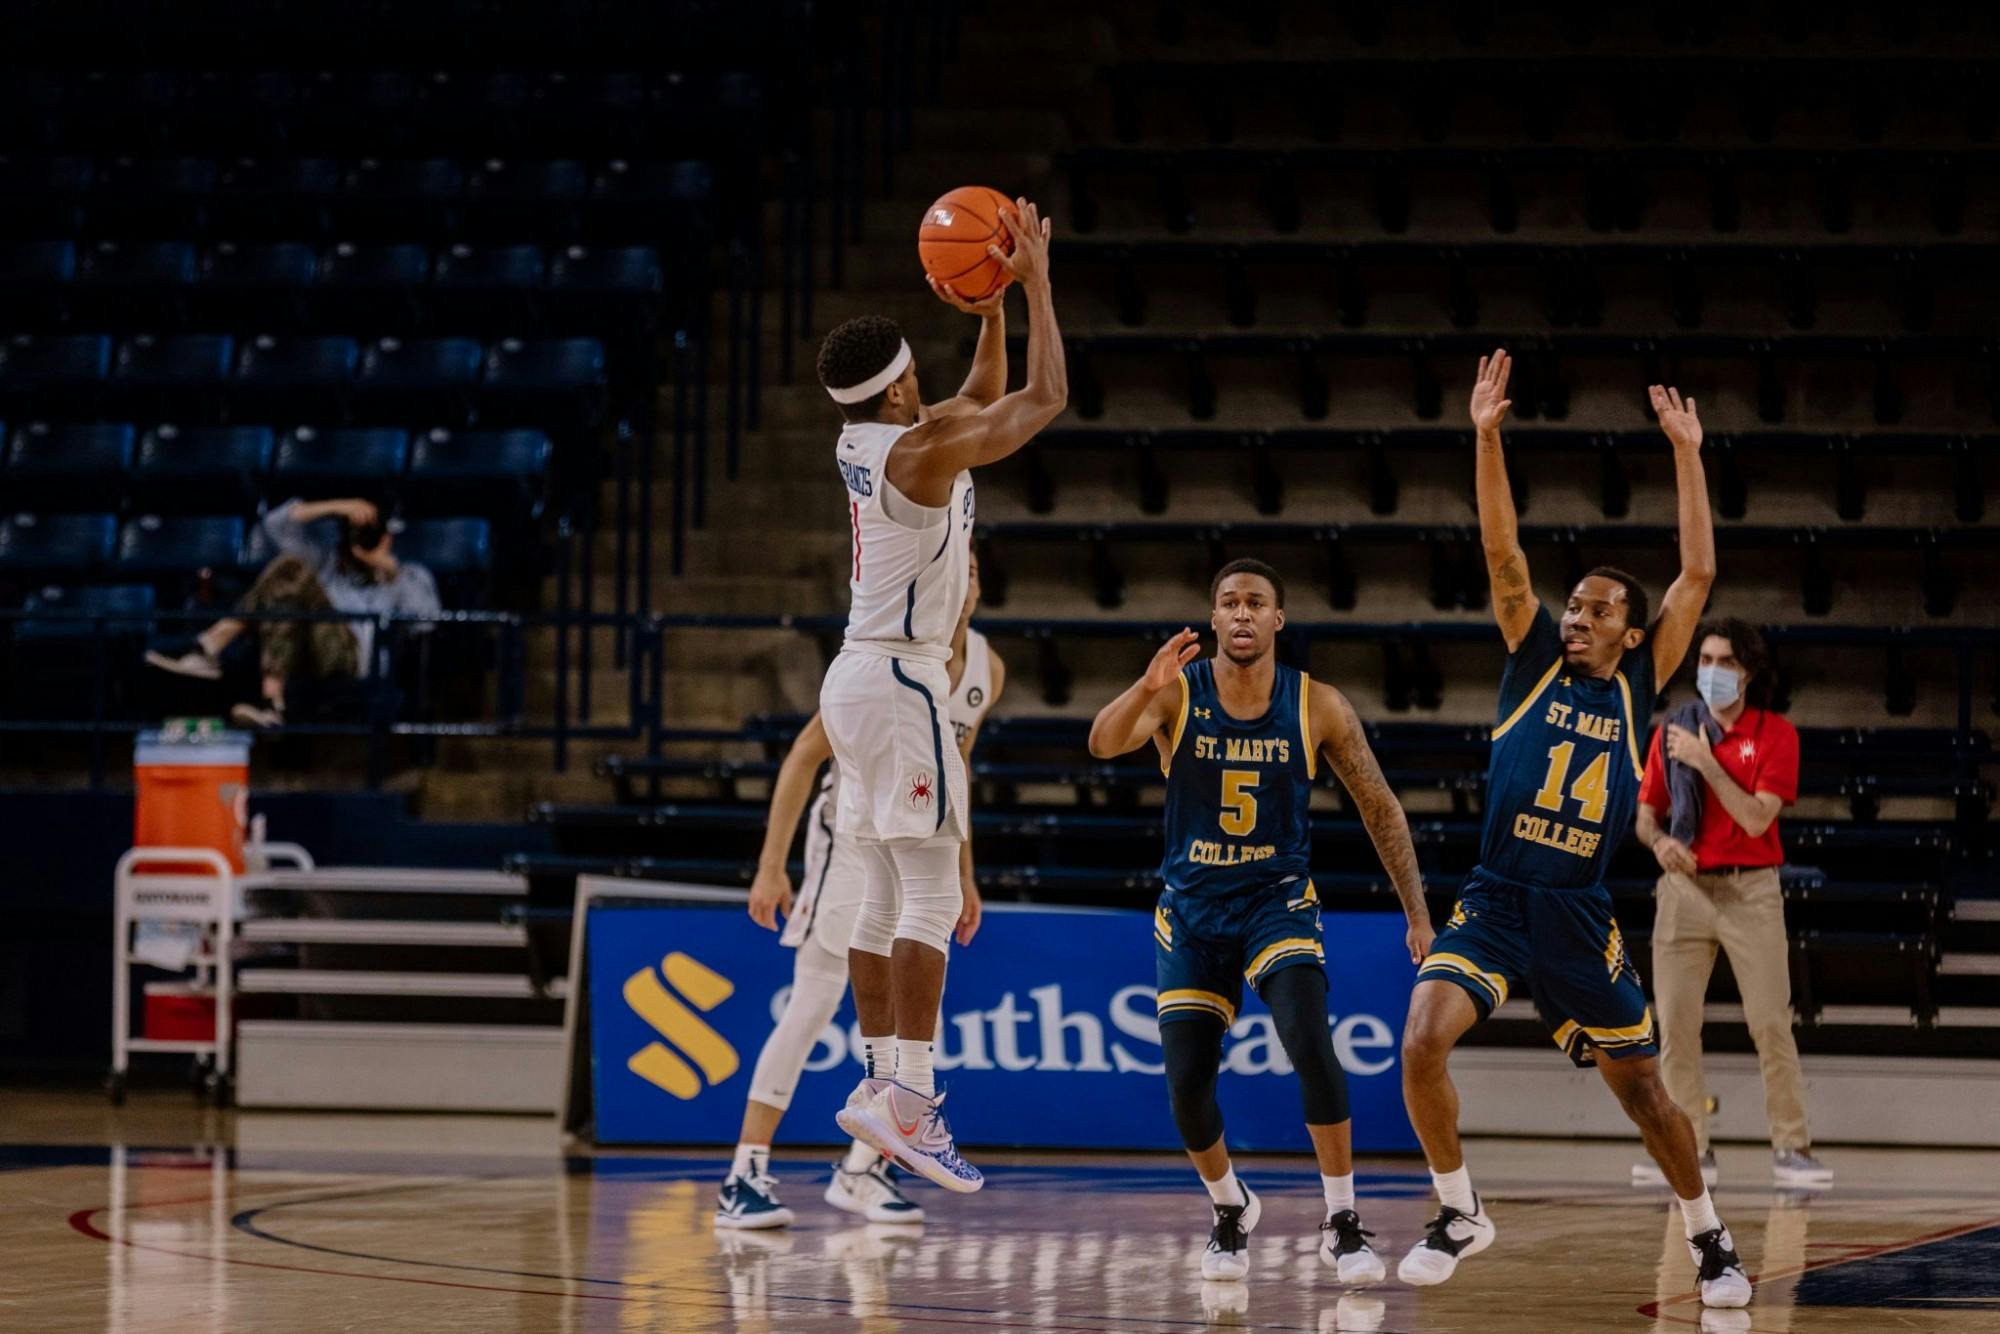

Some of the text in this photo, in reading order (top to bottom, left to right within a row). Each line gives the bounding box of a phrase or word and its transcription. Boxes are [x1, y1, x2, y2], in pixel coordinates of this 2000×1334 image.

[1545, 701, 1573, 730] ST.
[1194, 735, 1290, 763] ST. MARY'S
[1219, 769, 1260, 837] 5
[1533, 740, 1611, 823] 14
